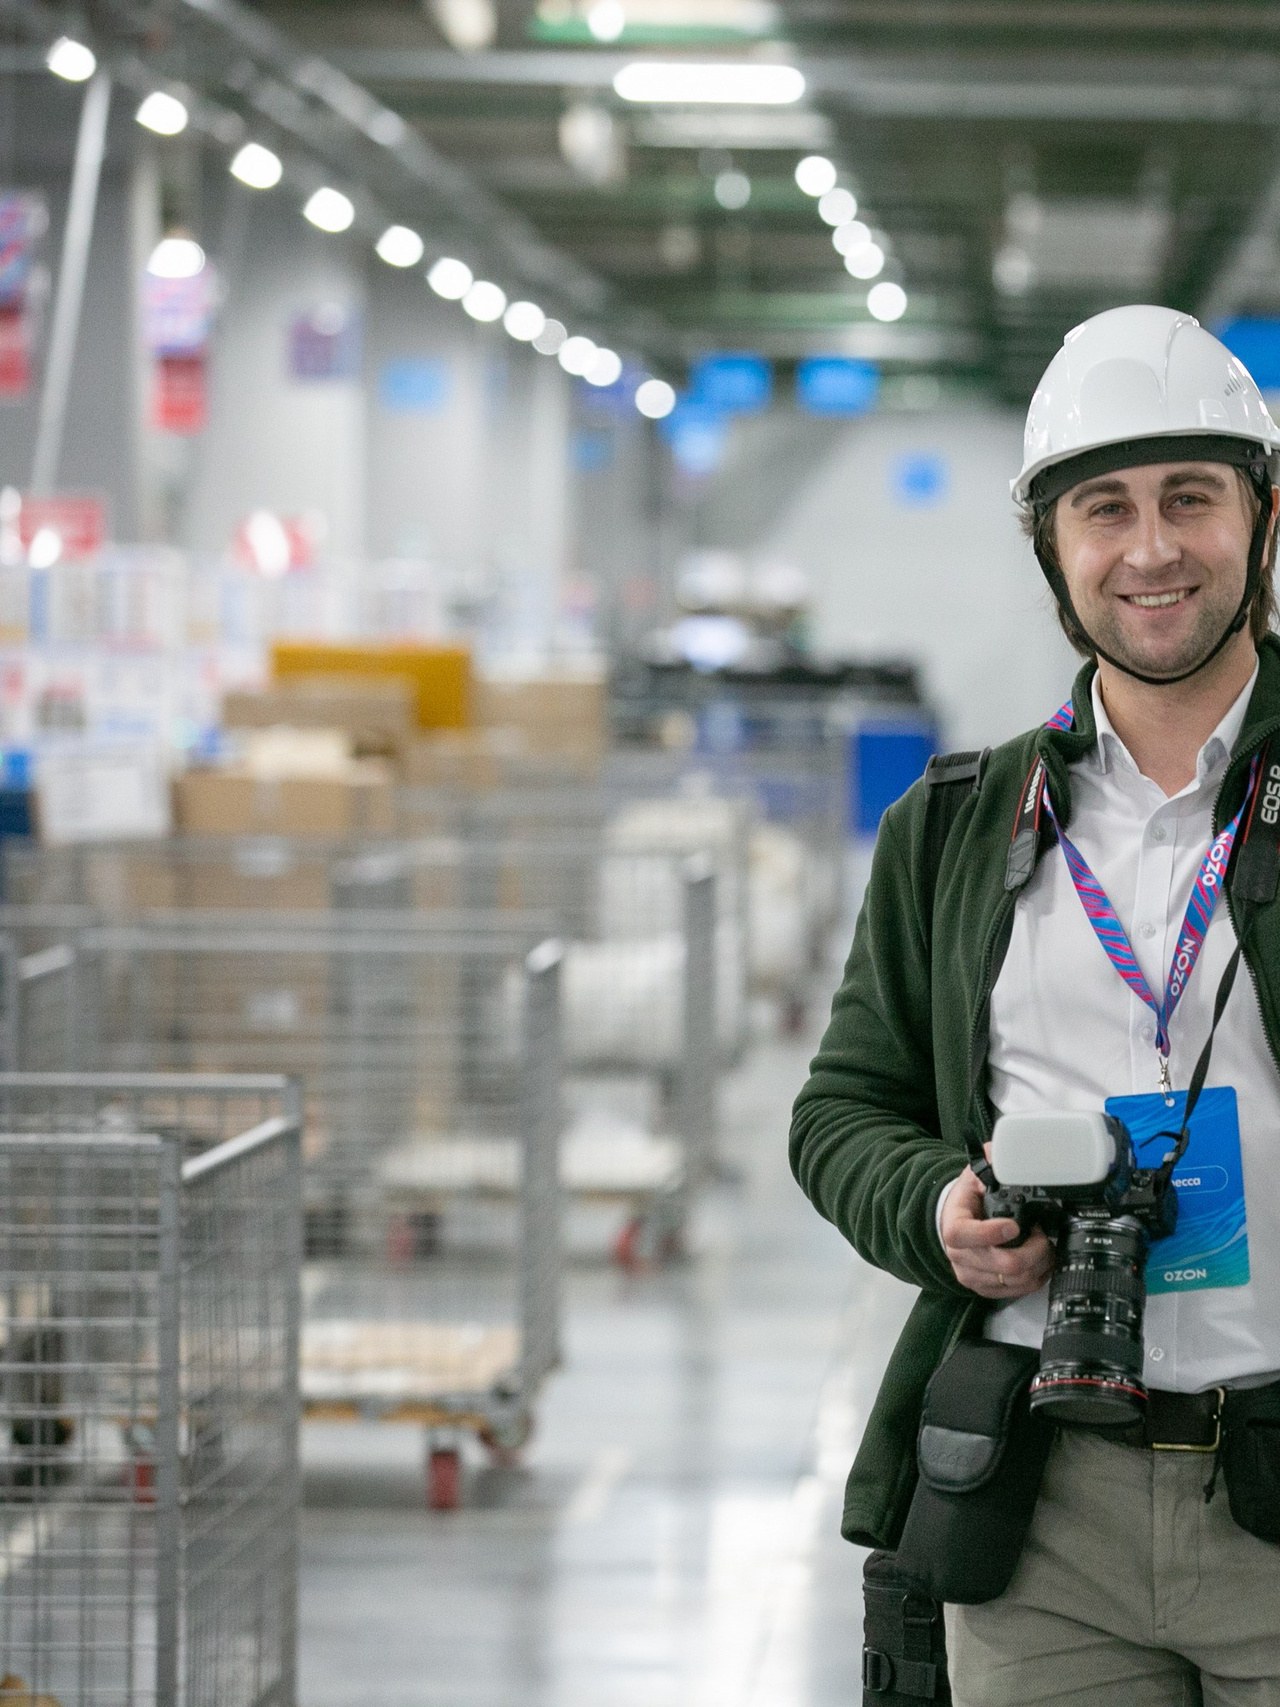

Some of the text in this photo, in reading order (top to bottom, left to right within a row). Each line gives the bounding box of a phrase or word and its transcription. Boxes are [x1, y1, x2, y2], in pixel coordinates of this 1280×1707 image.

[1202, 831, 1230, 886] OZON
[1170, 937, 1196, 996] OZON
[1163, 1268, 1207, 1282] OZON
